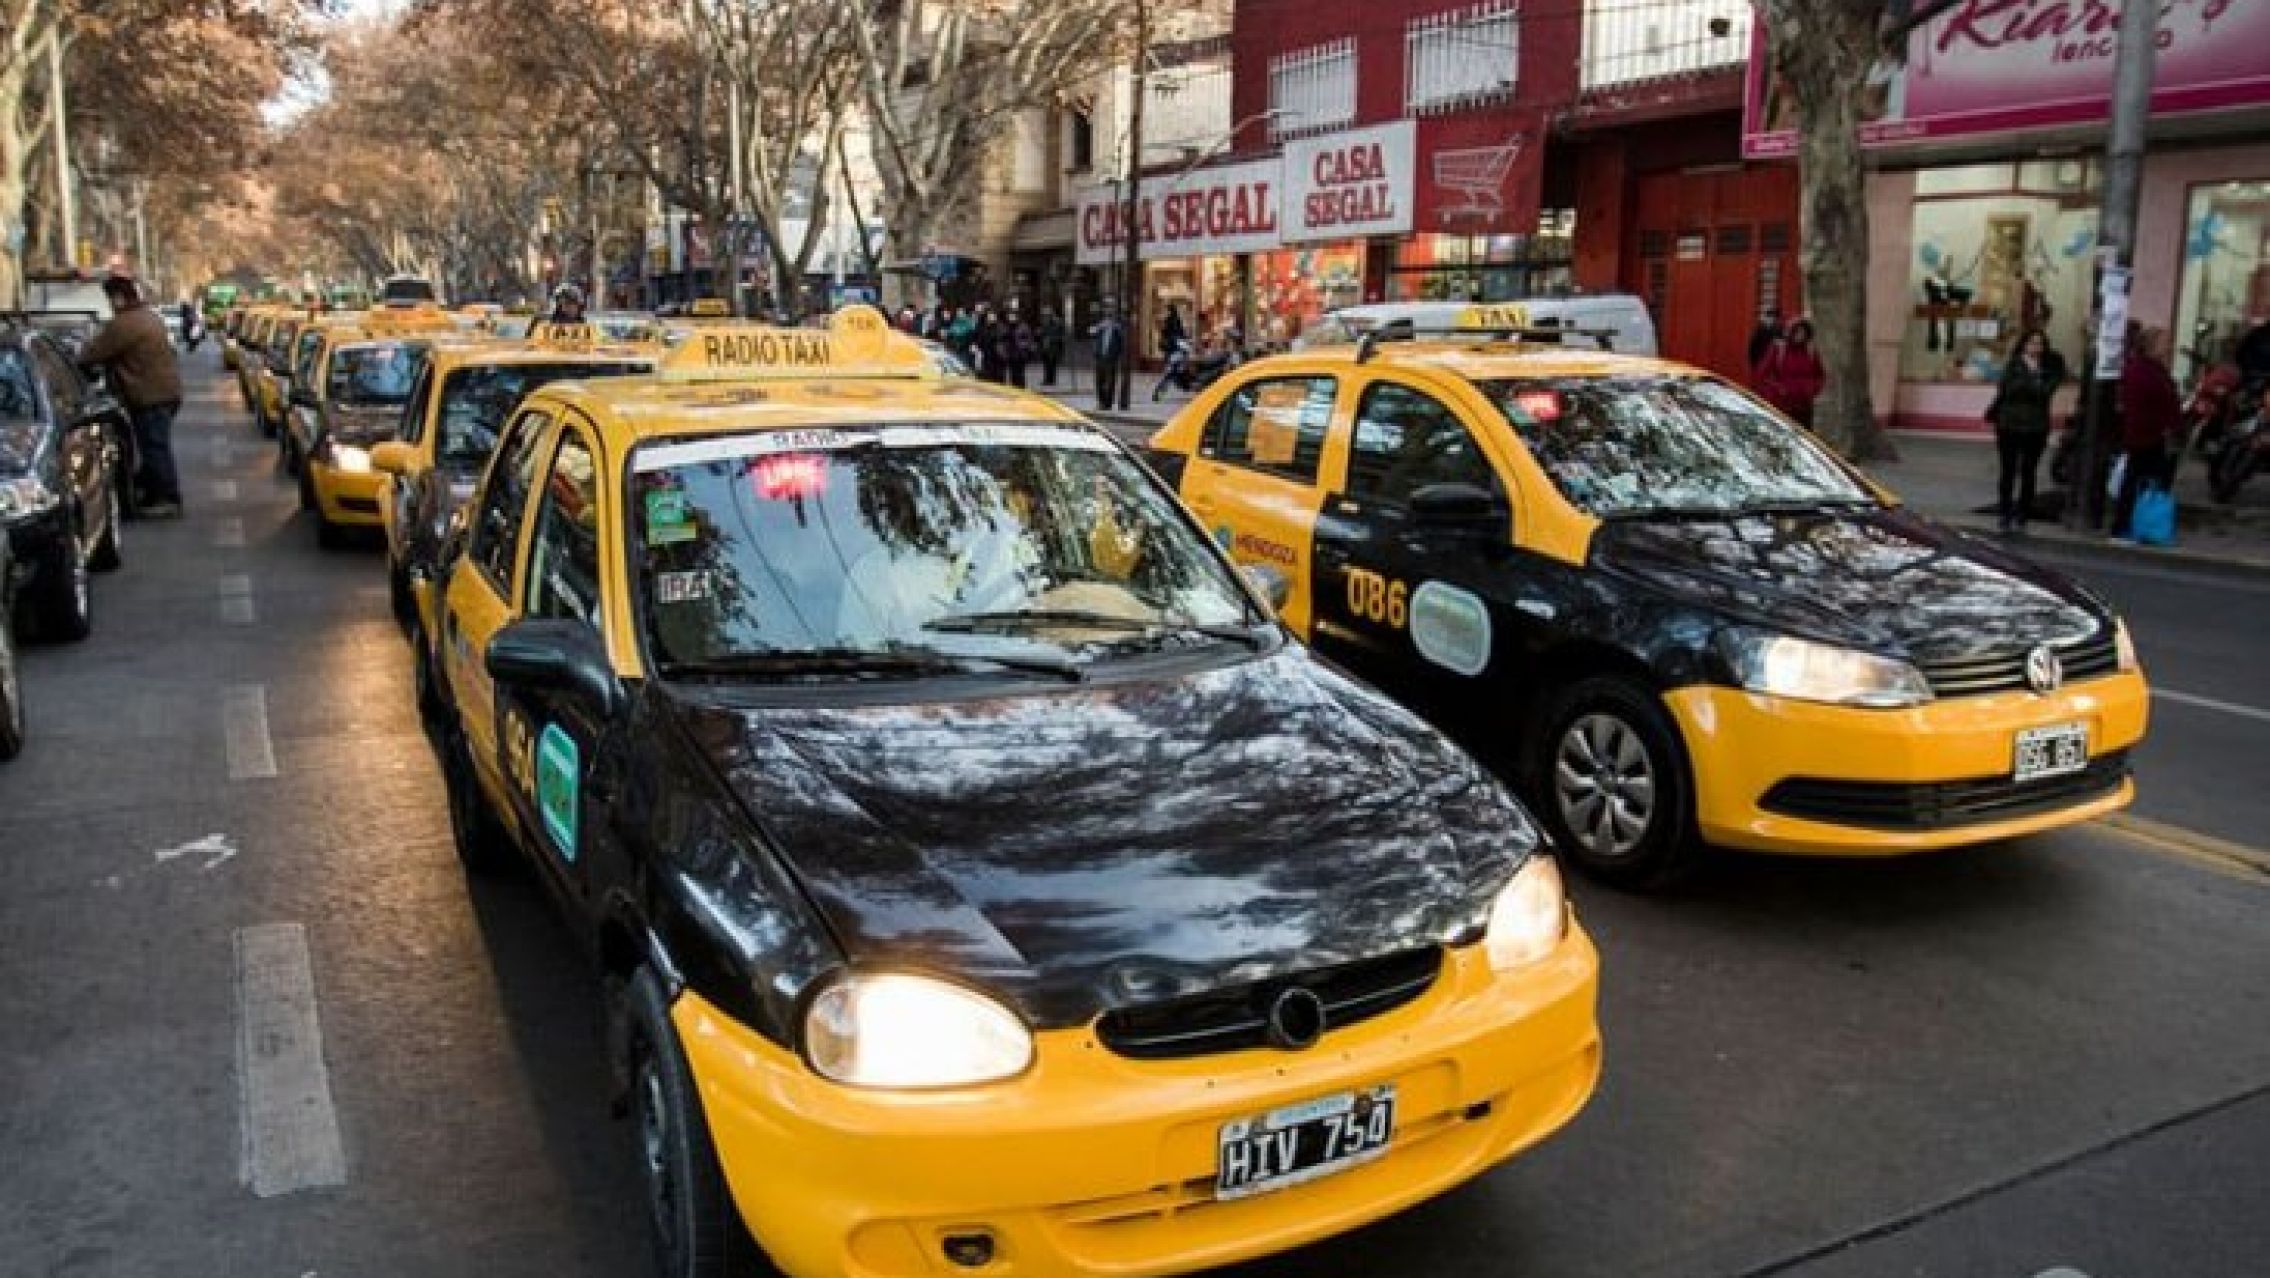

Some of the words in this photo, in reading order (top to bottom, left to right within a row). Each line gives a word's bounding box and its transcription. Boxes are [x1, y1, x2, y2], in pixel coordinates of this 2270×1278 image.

[1314, 142, 1385, 187] CASA
[1083, 198, 1155, 248] CASA
[1164, 182, 1277, 240] SEGAL
[1305, 183, 1395, 228] SEGAL
[1473, 307, 1528, 328] TAXI
[704, 334, 777, 366] RADIO
[781, 333, 830, 365] TAXI
[1347, 567, 1407, 628] 086
[1227, 1126, 1299, 1186] HIV
[1322, 1102, 1388, 1159] 750
